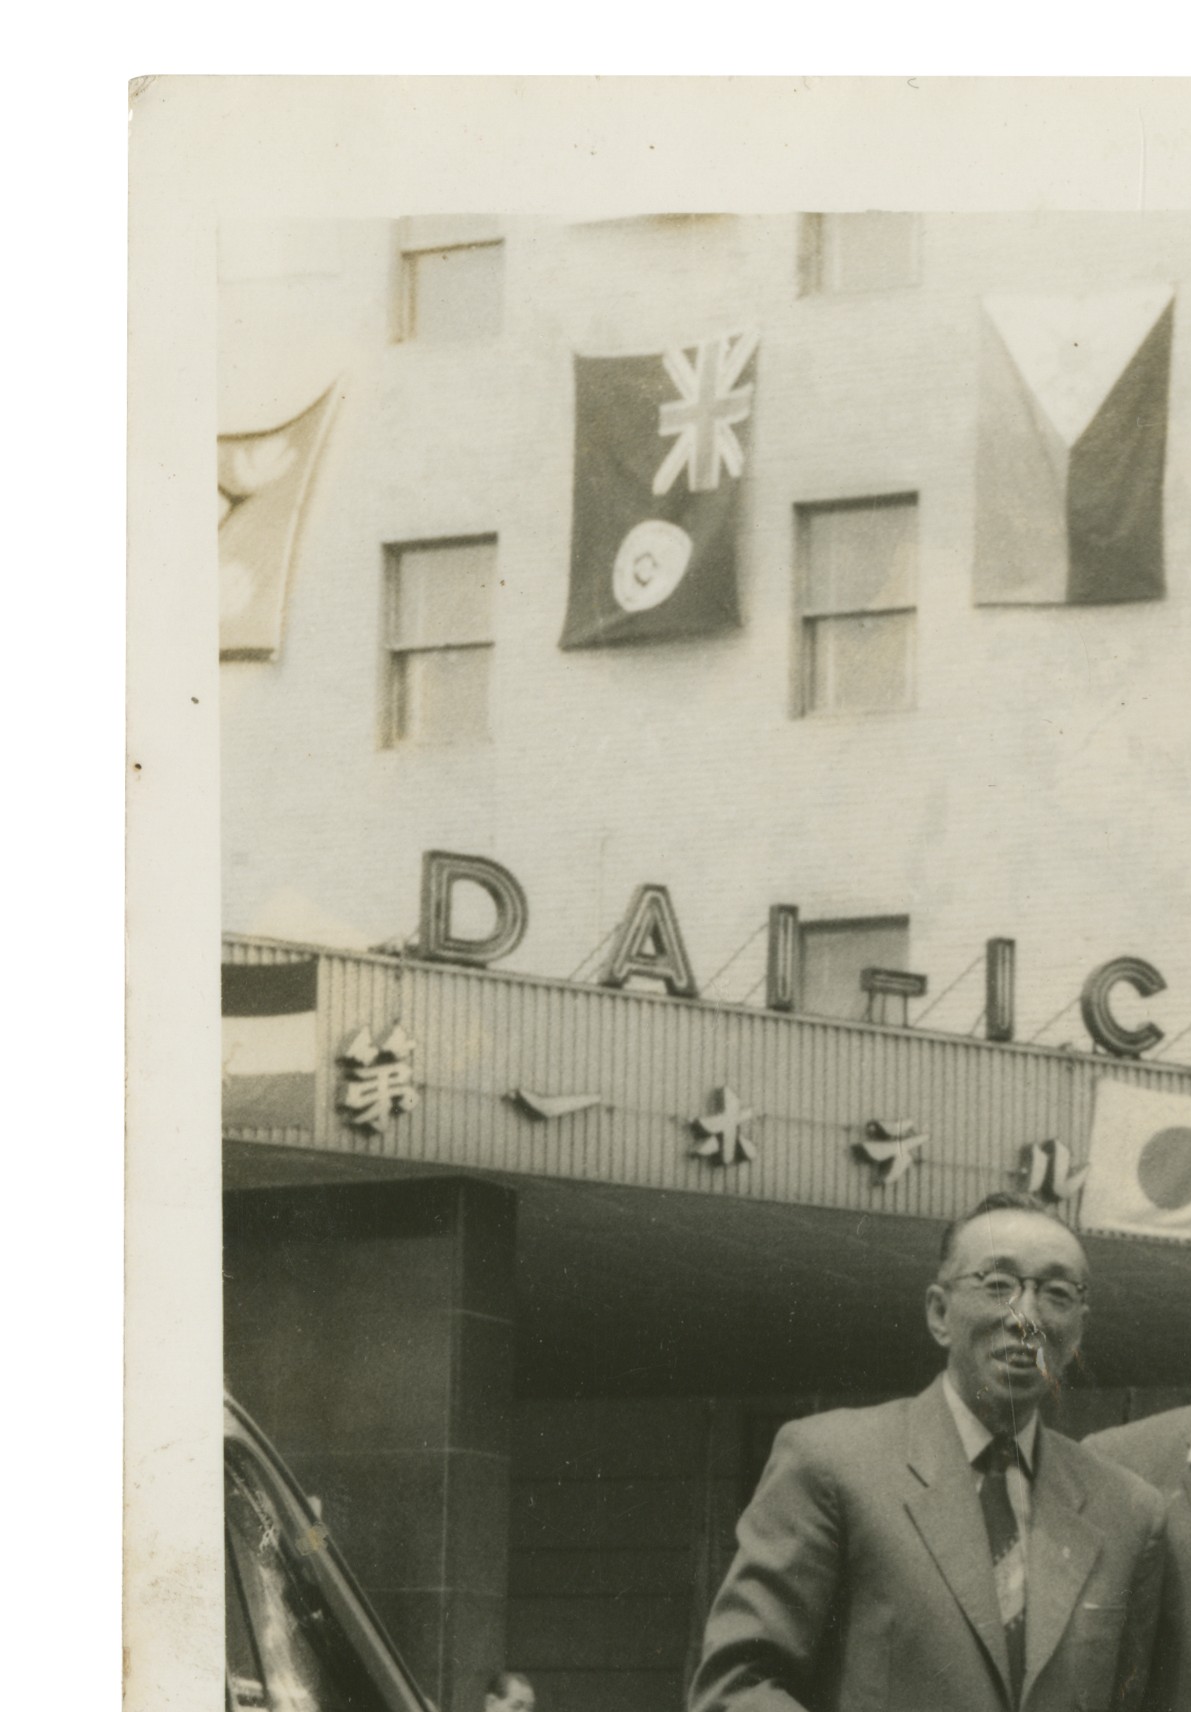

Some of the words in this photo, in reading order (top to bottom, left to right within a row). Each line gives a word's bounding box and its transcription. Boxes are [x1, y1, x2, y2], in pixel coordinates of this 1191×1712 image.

[336, 1017, 1088, 1202] 第一ホテル
